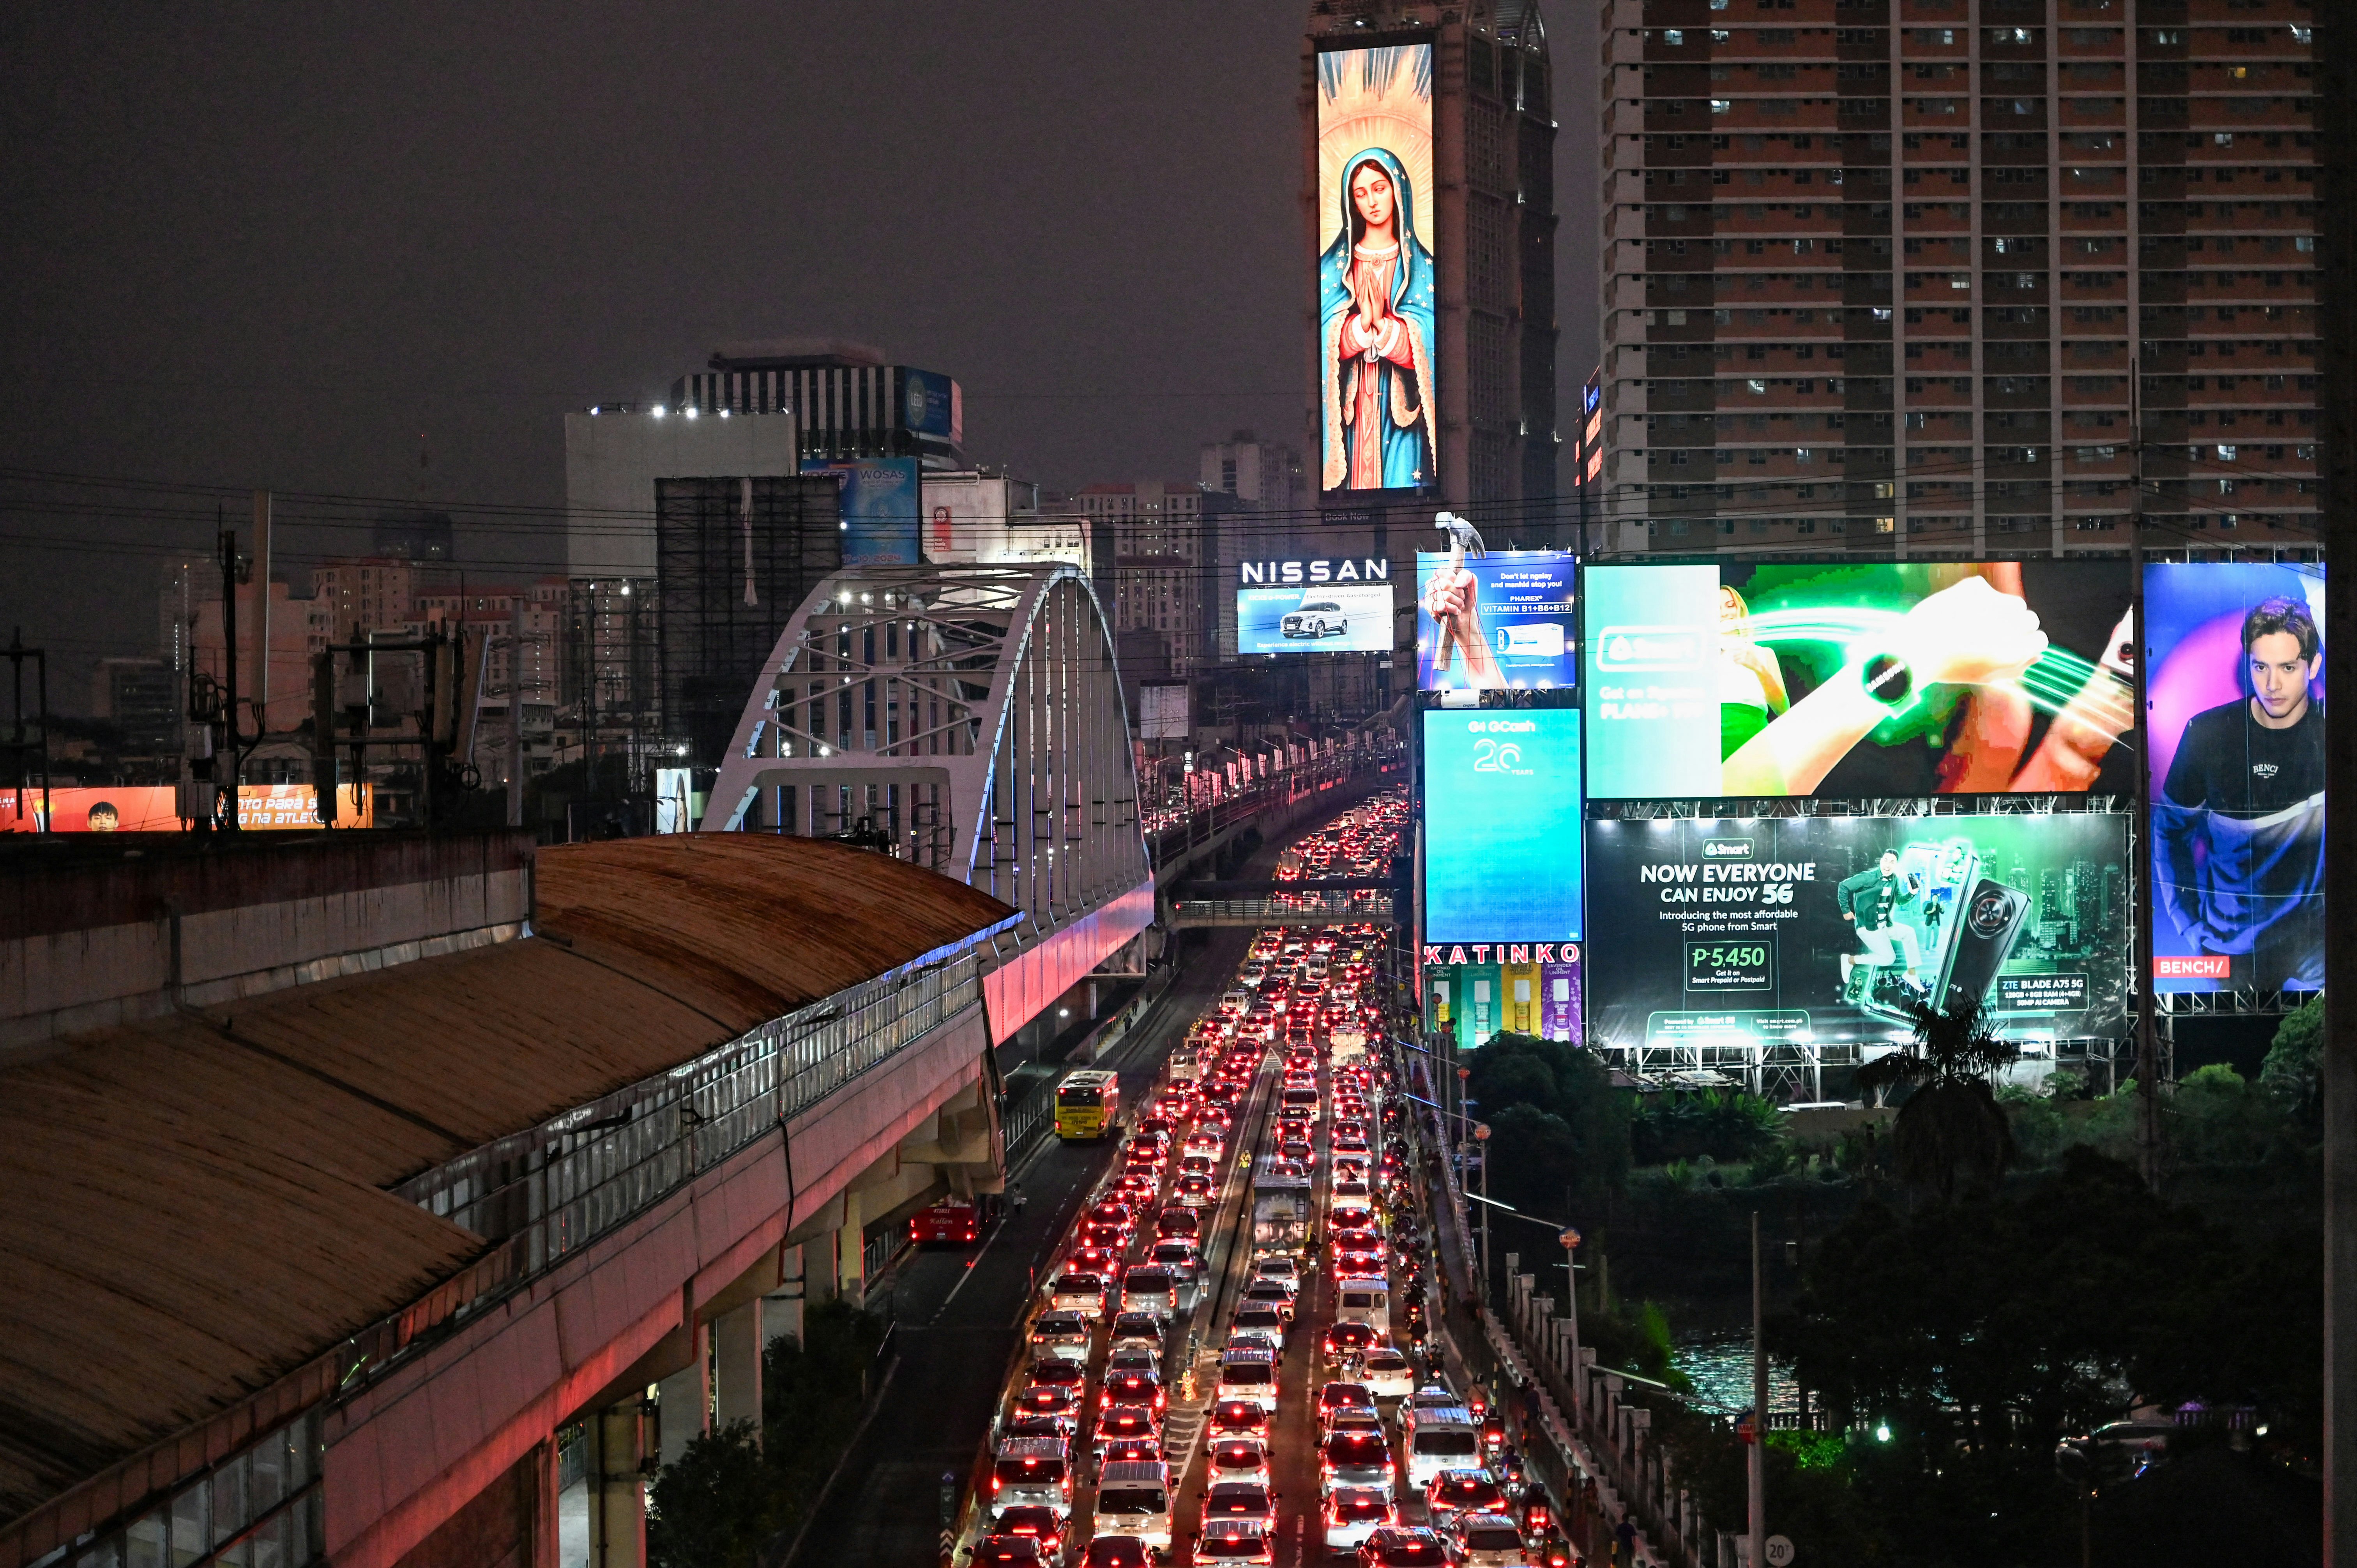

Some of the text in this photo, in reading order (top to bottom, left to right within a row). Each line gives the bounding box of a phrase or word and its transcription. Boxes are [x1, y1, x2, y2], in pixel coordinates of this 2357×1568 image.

[860, 470, 905, 479] WOSAS
[1325, 512, 1347, 521] Book
[1242, 559, 1387, 583] NISSAN
[1488, 720, 1535, 732] GCash
[1474, 738, 1521, 773] 20
[1717, 843, 1749, 855] Smart
[1641, 863, 1816, 883] NOW EVERYONE
[1661, 883, 1794, 904] CAN ENJOY 5G
[1660, 911, 1710, 921] Introducing
[1712, 911, 1727, 920] the
[1754, 909, 1798, 918] affordable
[1682, 922, 1777, 932] 5G phone from Smart
[1424, 943, 1579, 965] KATINKO
[2002, 979, 2083, 989] ZTE BLADE A75 5G
